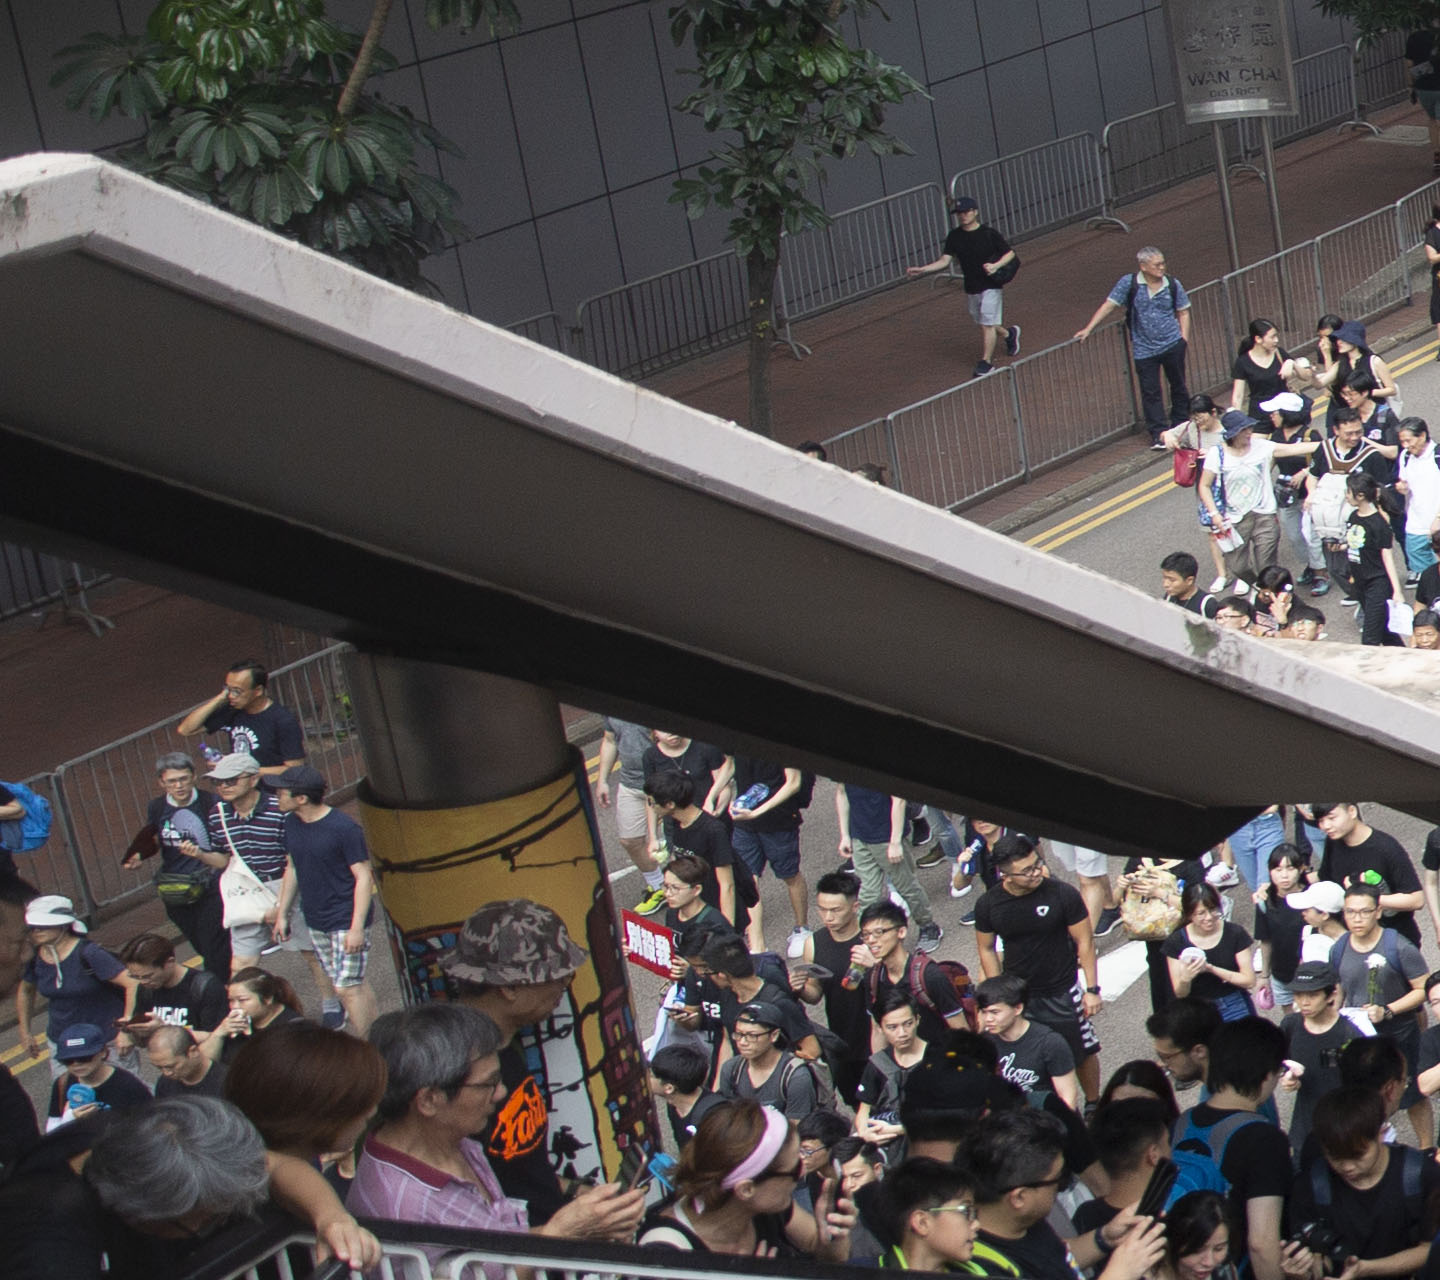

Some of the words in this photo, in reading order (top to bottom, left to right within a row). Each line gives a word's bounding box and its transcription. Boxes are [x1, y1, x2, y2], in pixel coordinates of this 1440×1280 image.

[1187, 71, 1231, 87] WAN
[1209, 84, 1263, 99] DISTRICT
[625, 919, 672, 970] 別殺我
